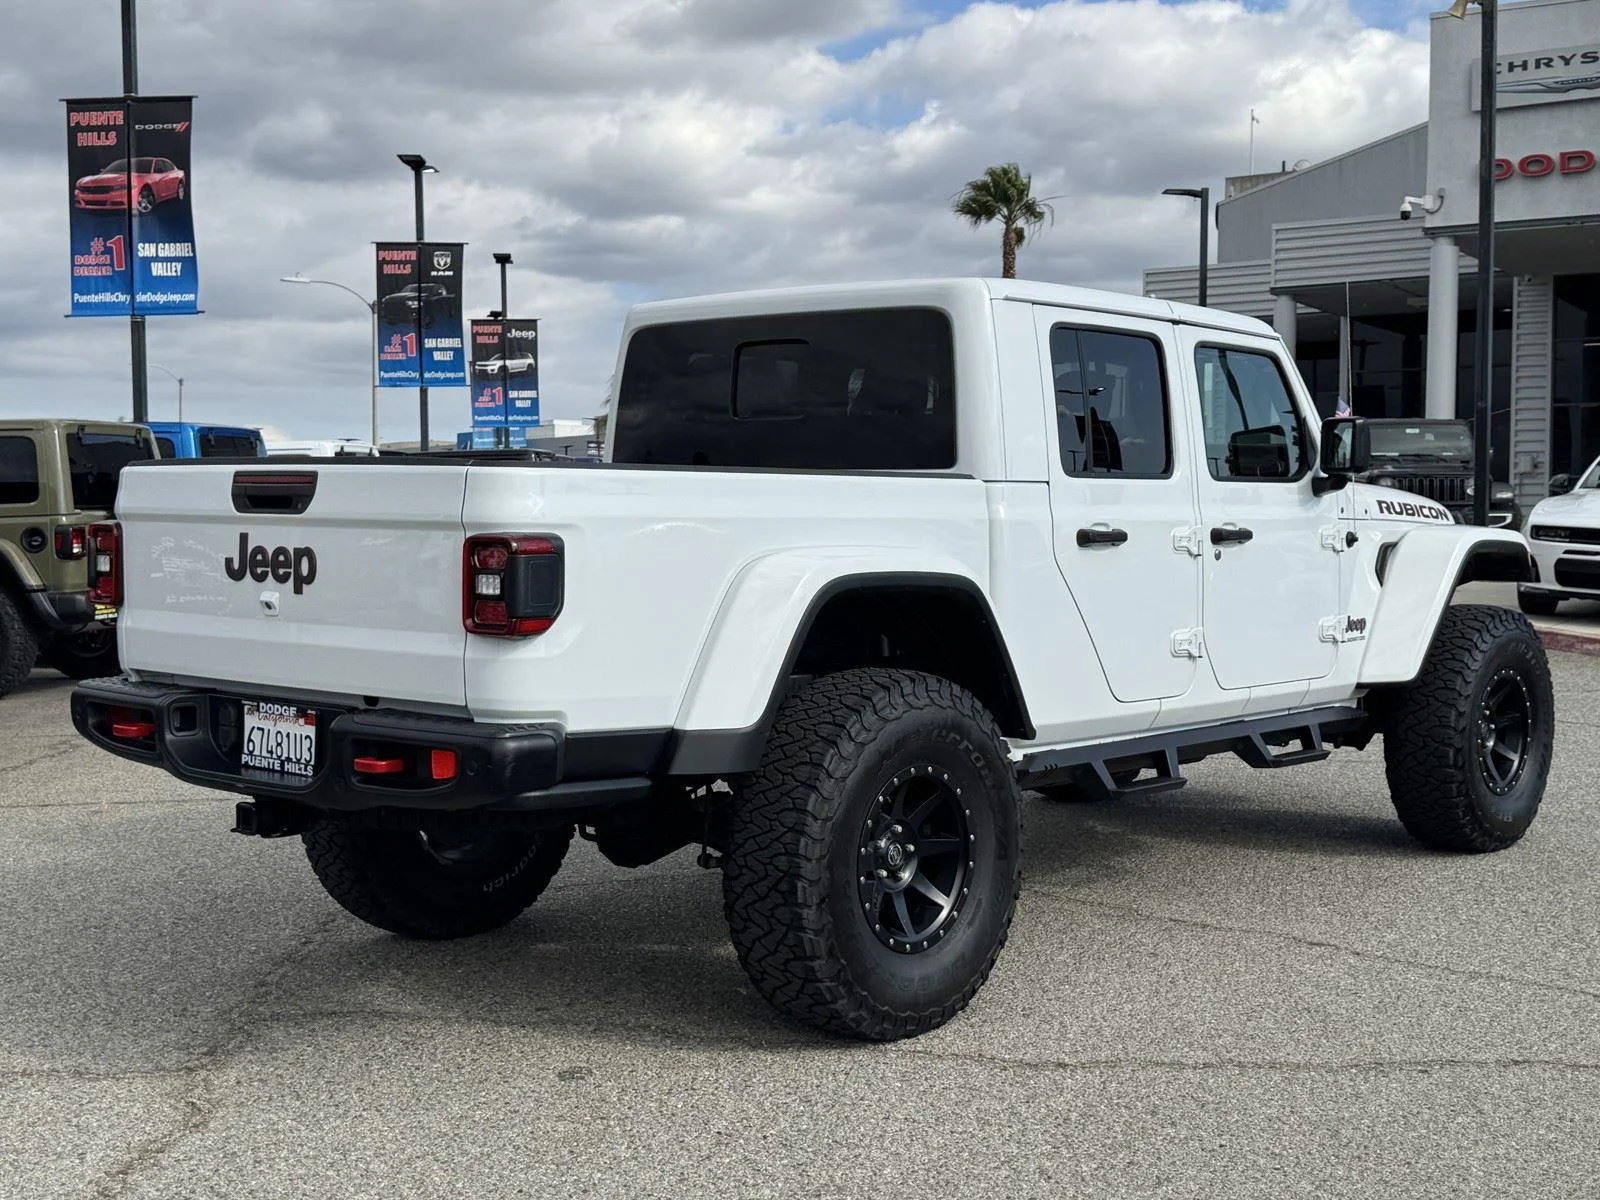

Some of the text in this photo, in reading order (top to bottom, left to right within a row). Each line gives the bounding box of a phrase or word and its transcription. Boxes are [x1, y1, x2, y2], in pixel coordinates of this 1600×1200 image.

[70, 110, 124, 126] PUENTE
[77, 131, 117, 147] HILLS
[137, 242, 194, 257] SAN GABRIEL
[378, 250, 417, 260] PUENTE
[74, 254, 111, 265] DODGE
[73, 266, 113, 276] DEALER
[150, 262, 182, 276] VALLEY
[383, 264, 412, 274] HILLS
[507, 328, 536, 340] Jeep
[424, 338, 437, 348] SAN
[433, 351, 454, 361] VALLEY
[1376, 500, 1450, 521] RUBICON
[225, 532, 317, 595] Jeep
[1345, 615, 1366, 634] Jeep
[260, 702, 297, 717] DODGE
[246, 726, 313, 764] 67481U3
[241, 753, 313, 776] PUENTE HILLS
